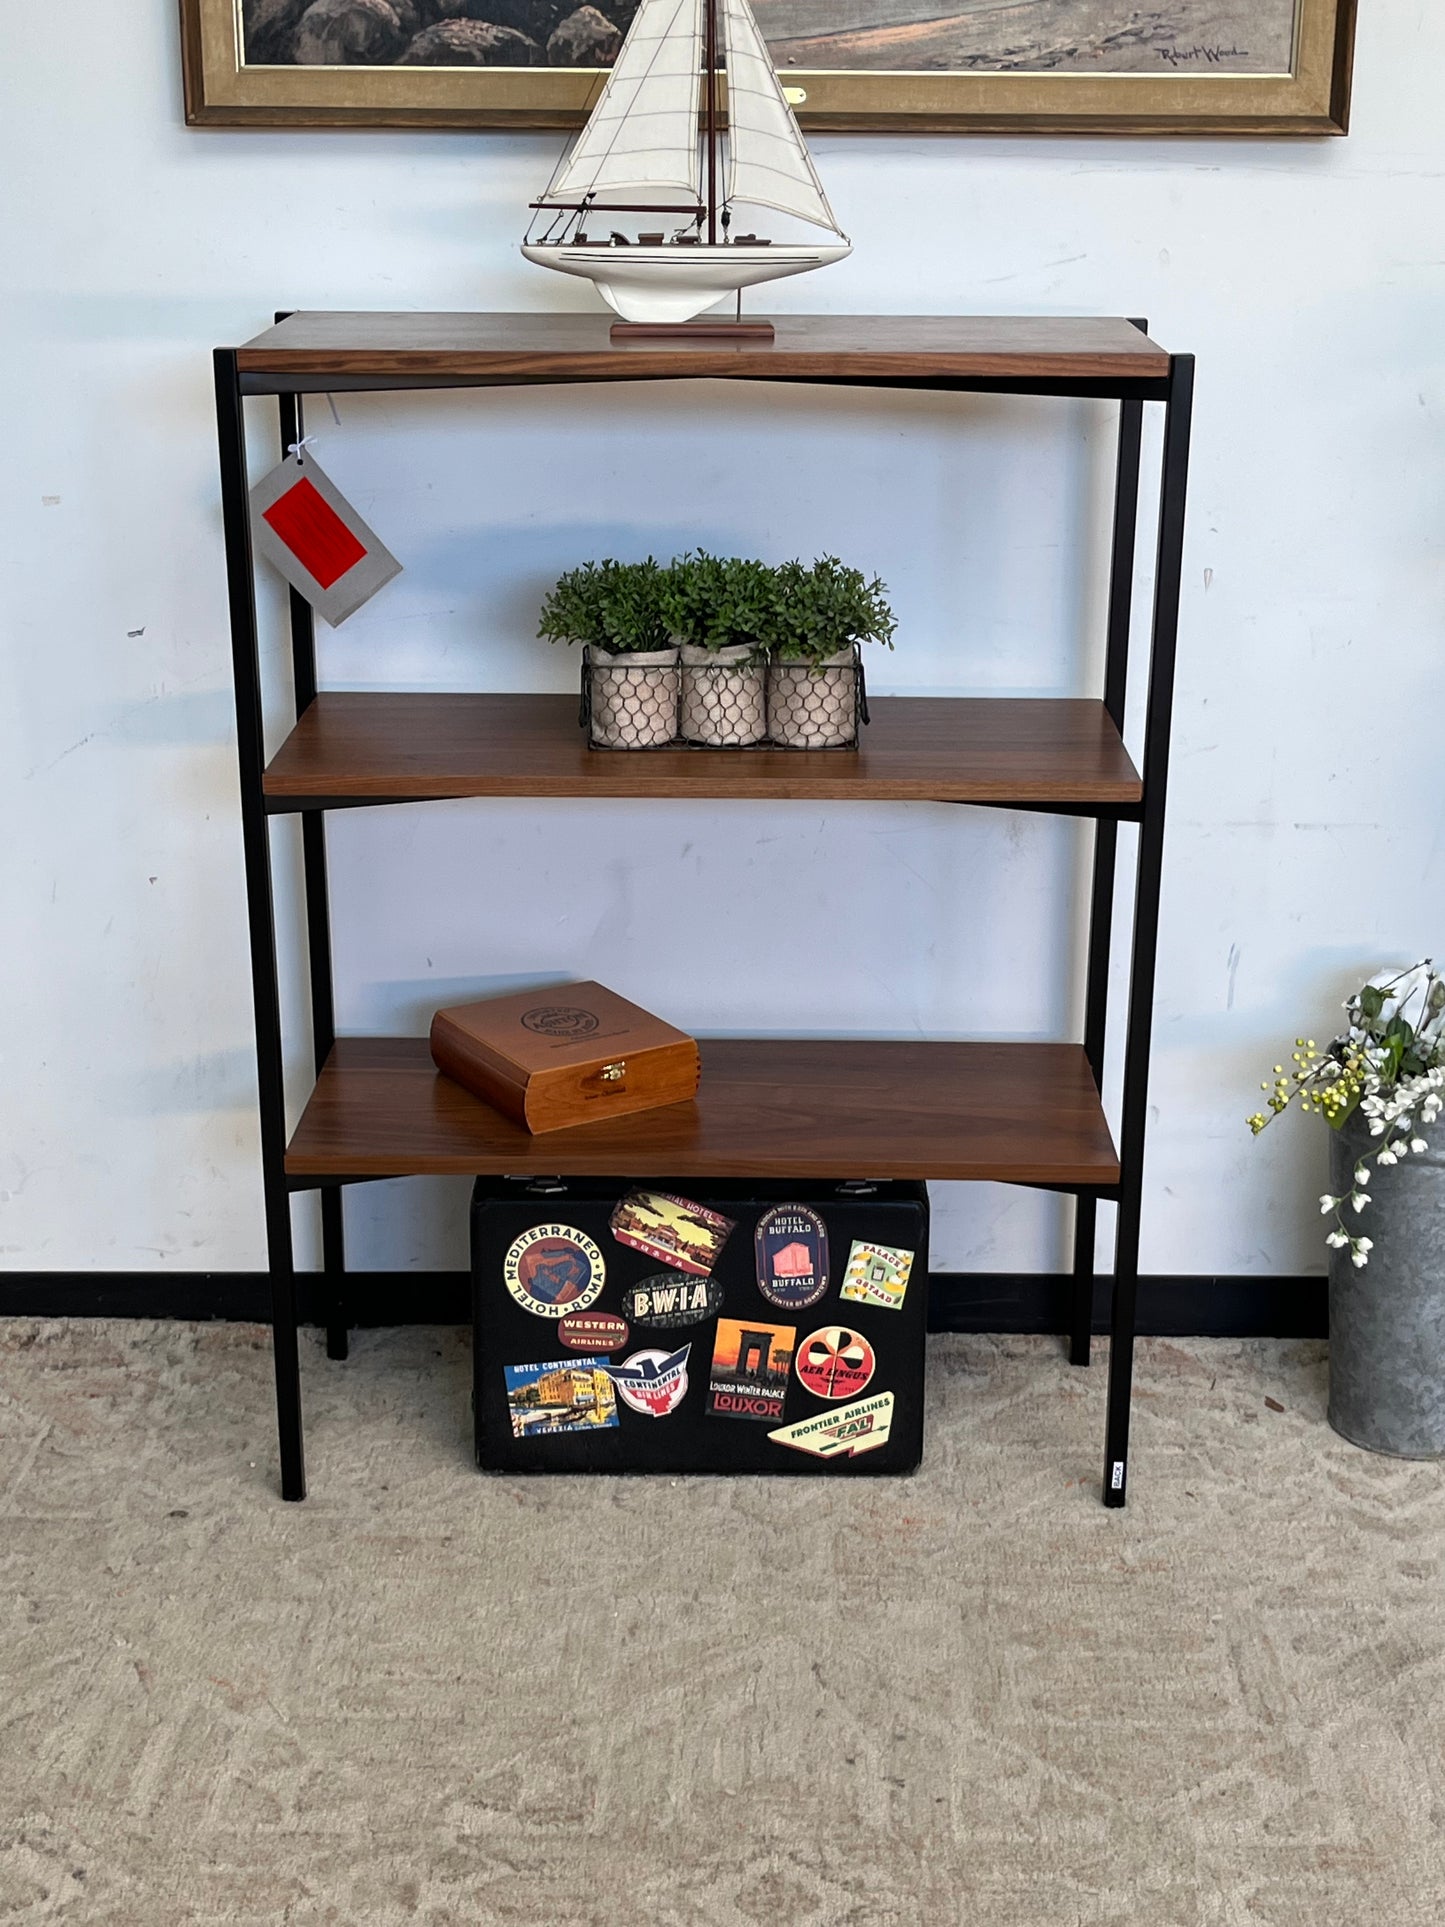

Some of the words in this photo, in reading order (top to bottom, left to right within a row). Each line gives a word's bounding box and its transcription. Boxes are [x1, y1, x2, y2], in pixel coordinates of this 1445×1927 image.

[1153, 45, 1201, 66] Robert
[1201, 45, 1248, 62] Wood
[686, 1202, 714, 1220] HOTEL
[769, 1224, 811, 1235] BUFFALO
[774, 1216, 804, 1226] HOTEL
[505, 1225, 600, 1281] MEDITERRANEO
[863, 1245, 901, 1268] PALACE
[571, 1272, 604, 1311] ROMA
[771, 1278, 815, 1288] BUFFALO
[512, 1285, 559, 1316] HOTEL
[563, 1320, 625, 1330] WESTERN
[570, 1338, 615, 1347] AIRLINES
[513, 1364, 539, 1374] HOTEL
[542, 1357, 598, 1370] CONTINENTAL
[800, 1365, 825, 1375] AER
[826, 1368, 870, 1380] LINGUS
[623, 1367, 681, 1389] CONTINENTAL
[761, 1388, 785, 1399] PALACE
[713, 1392, 783, 1417] LOUXOR
[790, 1415, 840, 1439] FRONTIER
[844, 1398, 891, 1421] AIRLINES
[836, 1417, 870, 1439] FAL
